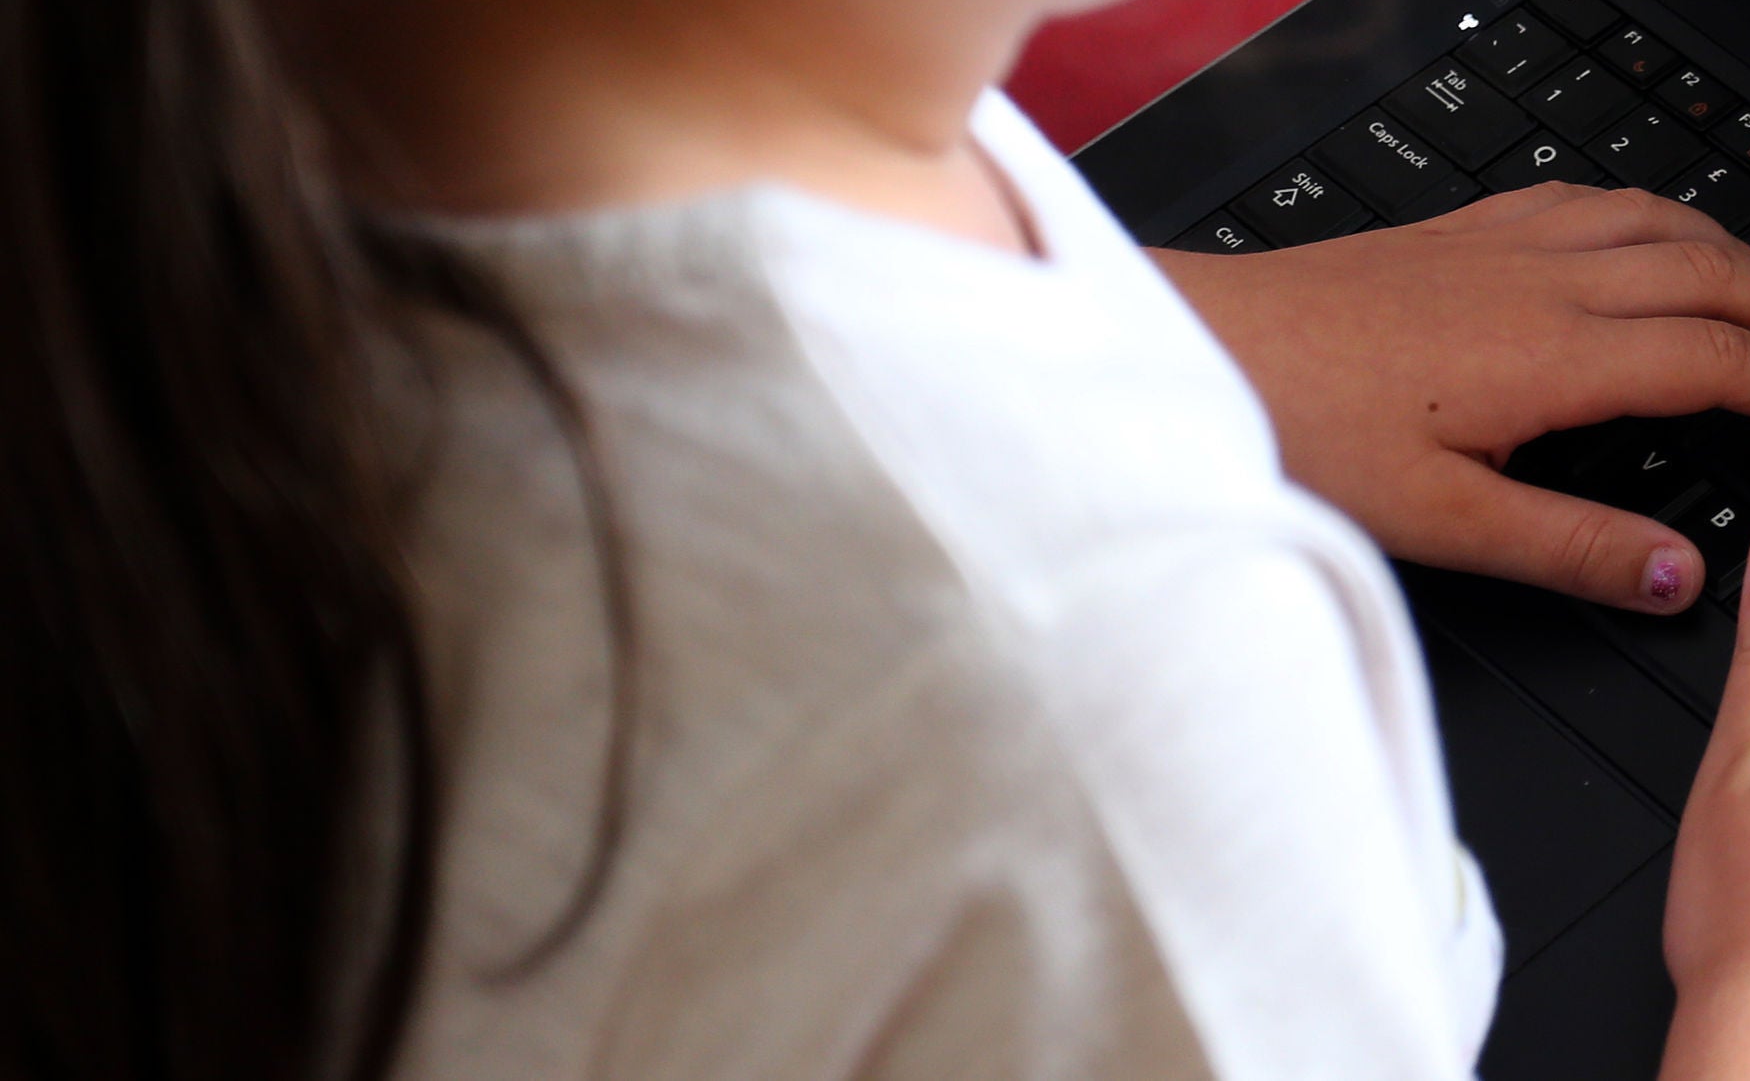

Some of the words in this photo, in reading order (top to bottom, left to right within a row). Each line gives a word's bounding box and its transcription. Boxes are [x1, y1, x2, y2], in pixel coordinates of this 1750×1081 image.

[1624, 30, 1643, 45] F1
[1444, 69, 1467, 92] Tab
[1681, 71, 1700, 86] F2
[1547, 89, 1562, 101] 1
[1368, 121, 1399, 149] Caps
[1397, 142, 1428, 169] Lock
[1611, 137, 1629, 152] 2
[1533, 145, 1556, 166] Q
[1292, 172, 1325, 199] Shift
[1708, 169, 1727, 182] £
[1679, 189, 1697, 201] 3
[1216, 226, 1244, 249] Ctrl
[1642, 451, 1667, 471] V
[1710, 507, 1736, 528] B
